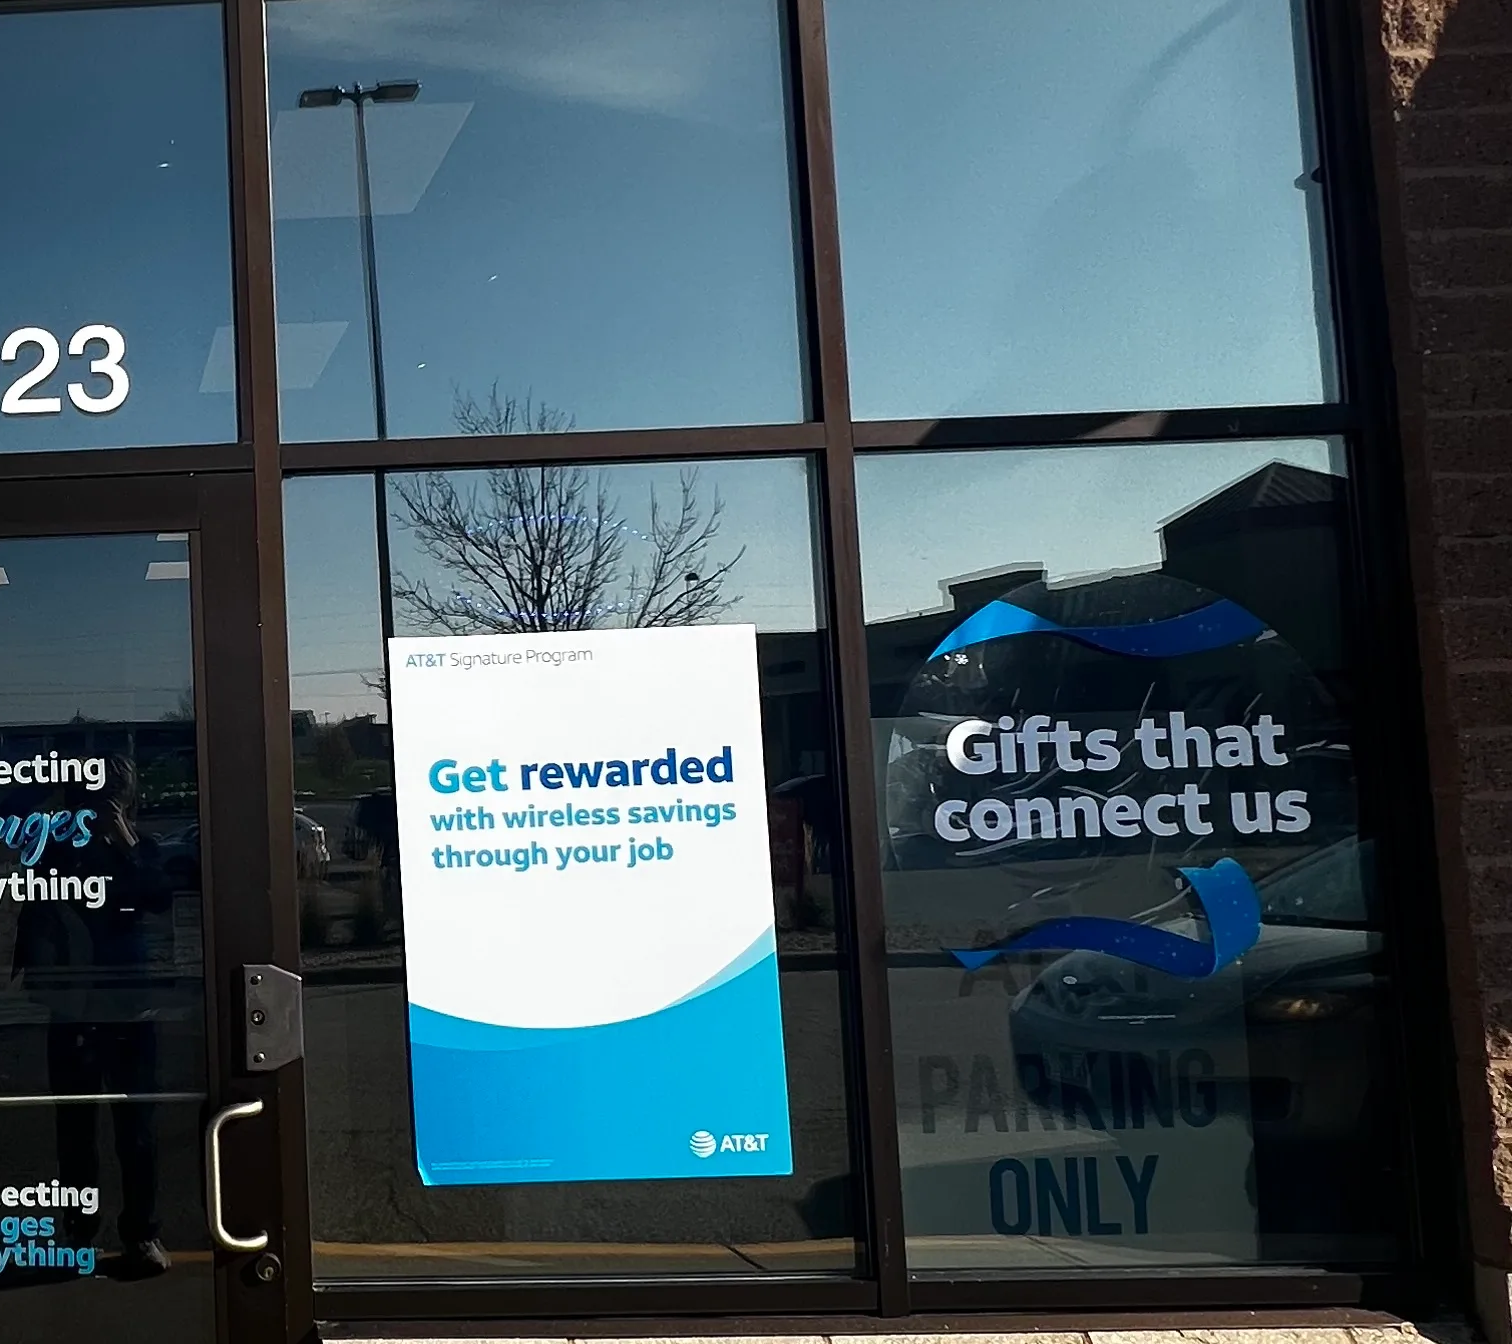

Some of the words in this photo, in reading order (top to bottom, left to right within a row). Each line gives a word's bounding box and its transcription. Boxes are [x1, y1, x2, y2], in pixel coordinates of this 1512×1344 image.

[405, 653, 446, 668] AT&T
[450, 651, 522, 670] Signature
[526, 648, 593, 668] Program
[945, 714, 1121, 775] Gifts
[1135, 711, 1288, 769] that
[428, 758, 509, 794] Get
[520, 745, 734, 791] rewarded
[430, 805, 495, 832] with
[502, 803, 620, 829] wireless
[628, 798, 737, 828] savings
[934, 783, 1214, 843] connect
[1230, 789, 1311, 834] us
[432, 841, 548, 873] through
[556, 845, 621, 871] your
[627, 837, 674, 868] job
[919, 1047, 1218, 1135] PARKING
[720, 1133, 769, 1153] AT&T
[988, 1154, 1160, 1237] ONLY
